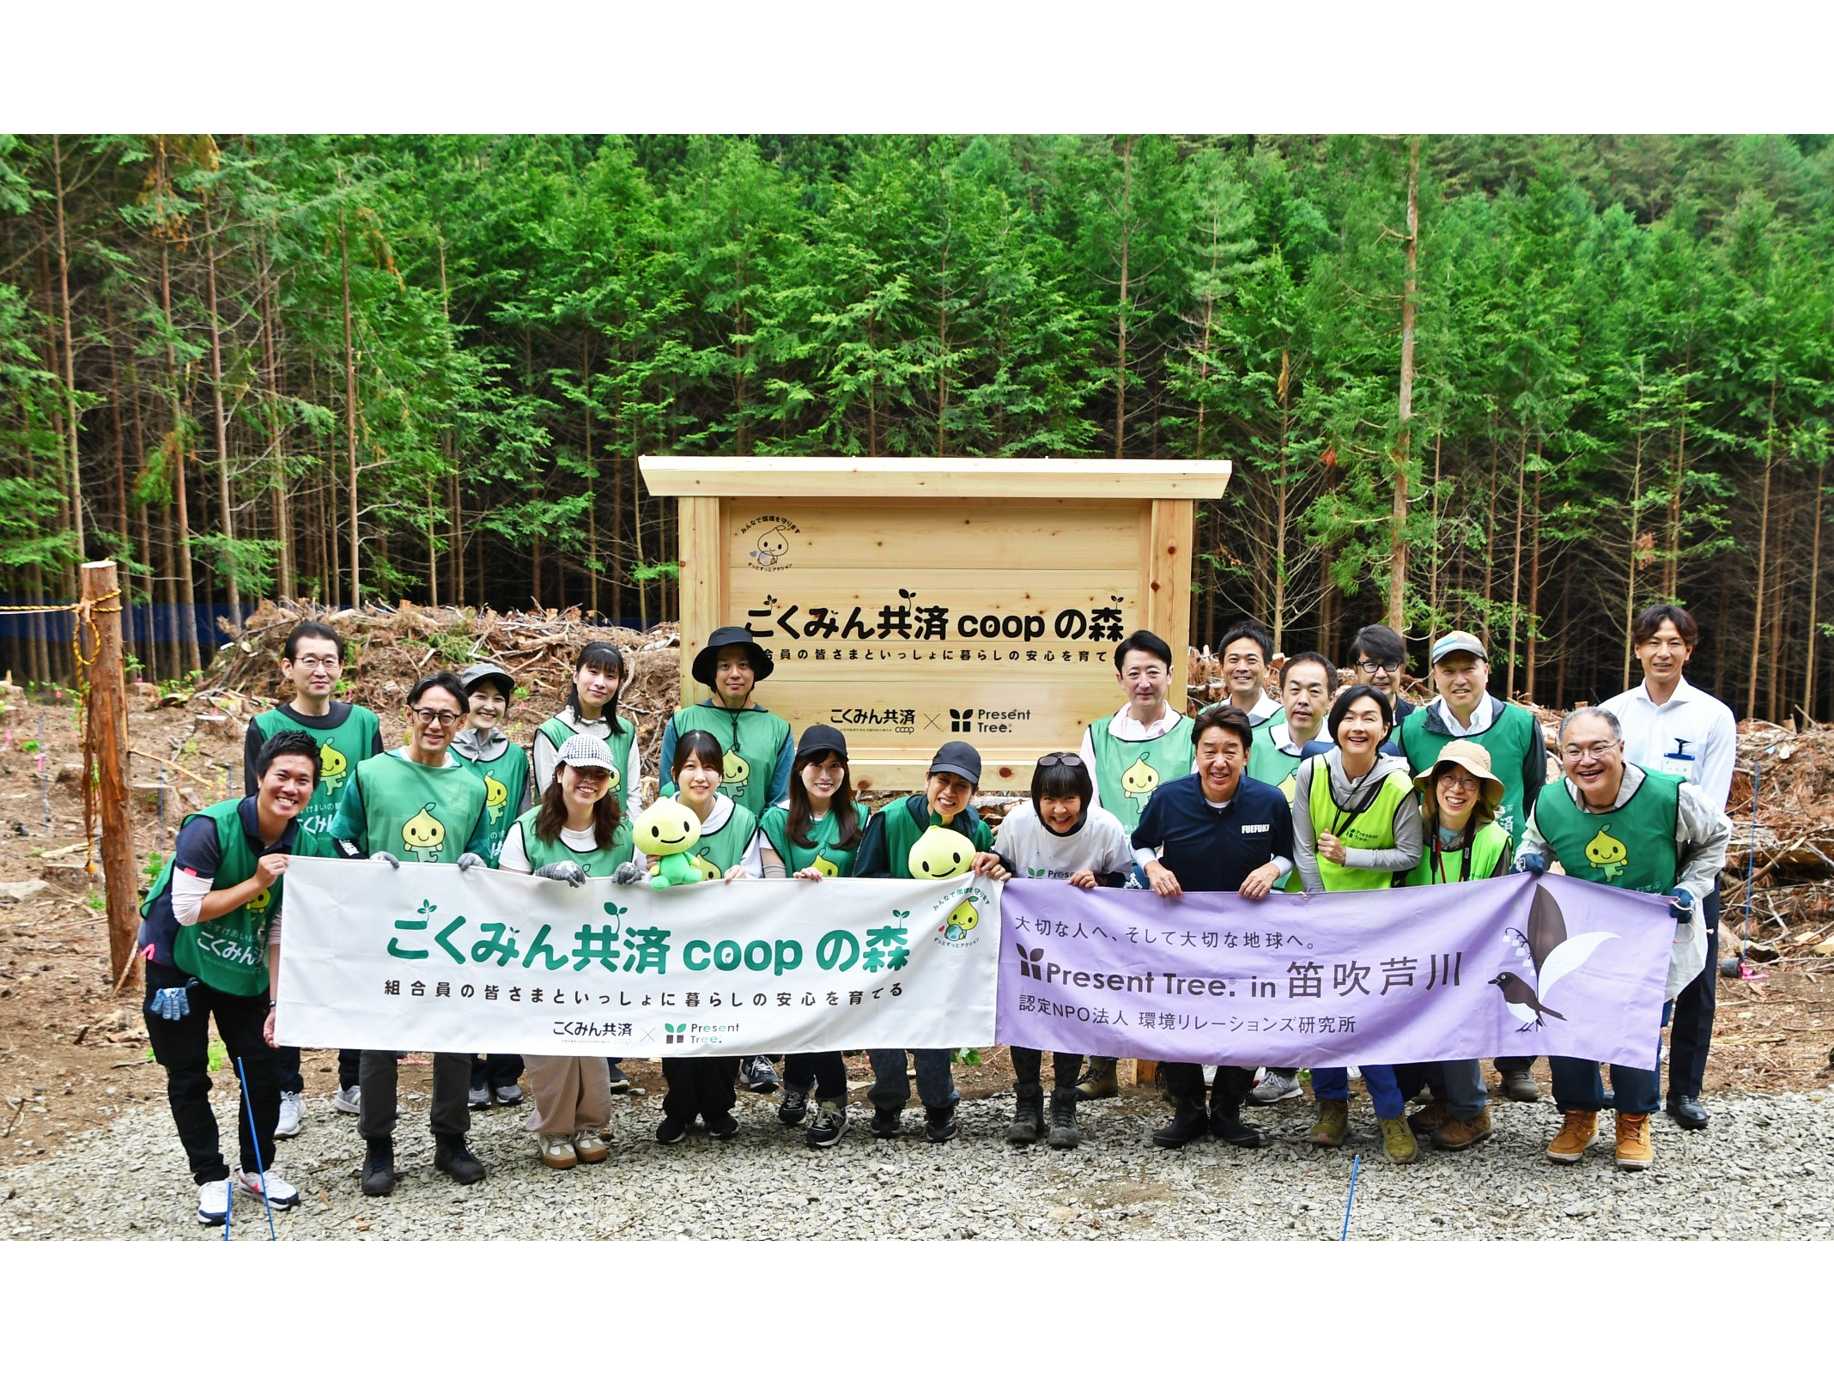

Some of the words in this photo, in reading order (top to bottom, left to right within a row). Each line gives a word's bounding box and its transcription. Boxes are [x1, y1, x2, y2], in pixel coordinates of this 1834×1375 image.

[745, 604, 949, 641] こくみん共済
[958, 615, 1045, 642] coop
[1054, 607, 1124, 642] の森
[765, 648, 1107, 662] 合員の皆さまといっしょに暮らしの安心を育て
[830, 708, 915, 725] こくみん共済
[977, 709, 1031, 720] Present
[1047, 870, 1075, 879] Pres
[387, 914, 671, 975] こくみん共済
[683, 938, 803, 976] coop
[816, 925, 911, 973] の森
[1015, 916, 1314, 950] 大切な人へ、そして大切な地球へ。
[197, 931, 256, 966] こくみん
[1047, 962, 1154, 993] Present
[1163, 972, 1235, 997] Tree.
[1251, 976, 1276, 998] in
[1286, 951, 1462, 999] 笛吹芦川
[384, 979, 903, 1007] 組合員の皆さまといっしょに暮らしの安心を育てる
[691, 1023, 739, 1033] Present
[1019, 994, 1129, 1026] 認定NPO法人
[1138, 1011, 1356, 1034] 環境リレーションズ研究所
[553, 1021, 633, 1037] こくみん共済
